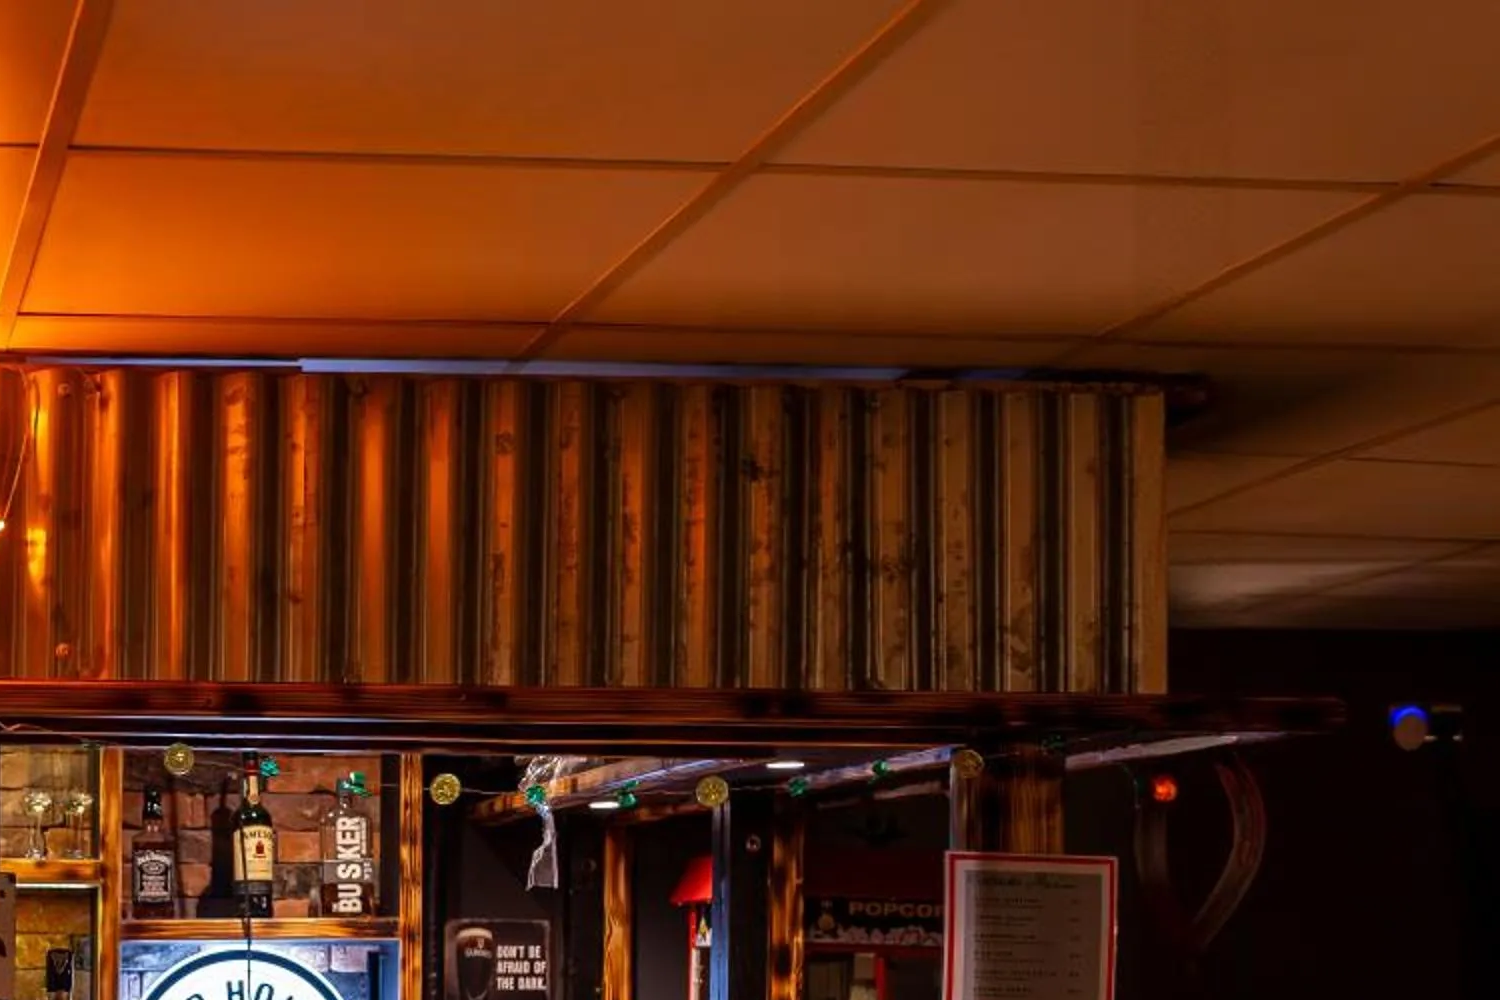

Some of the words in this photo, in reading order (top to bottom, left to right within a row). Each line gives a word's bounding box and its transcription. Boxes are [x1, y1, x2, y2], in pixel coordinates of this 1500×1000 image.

[336, 816, 362, 913] BUSKER
[0, 890, 7, 899] a
[496, 944, 525, 959] DON'T
[527, 944, 542, 959] BE
[496, 960, 531, 974] AFRAID
[533, 960, 547, 974] OF
[496, 976, 515, 991] THE
